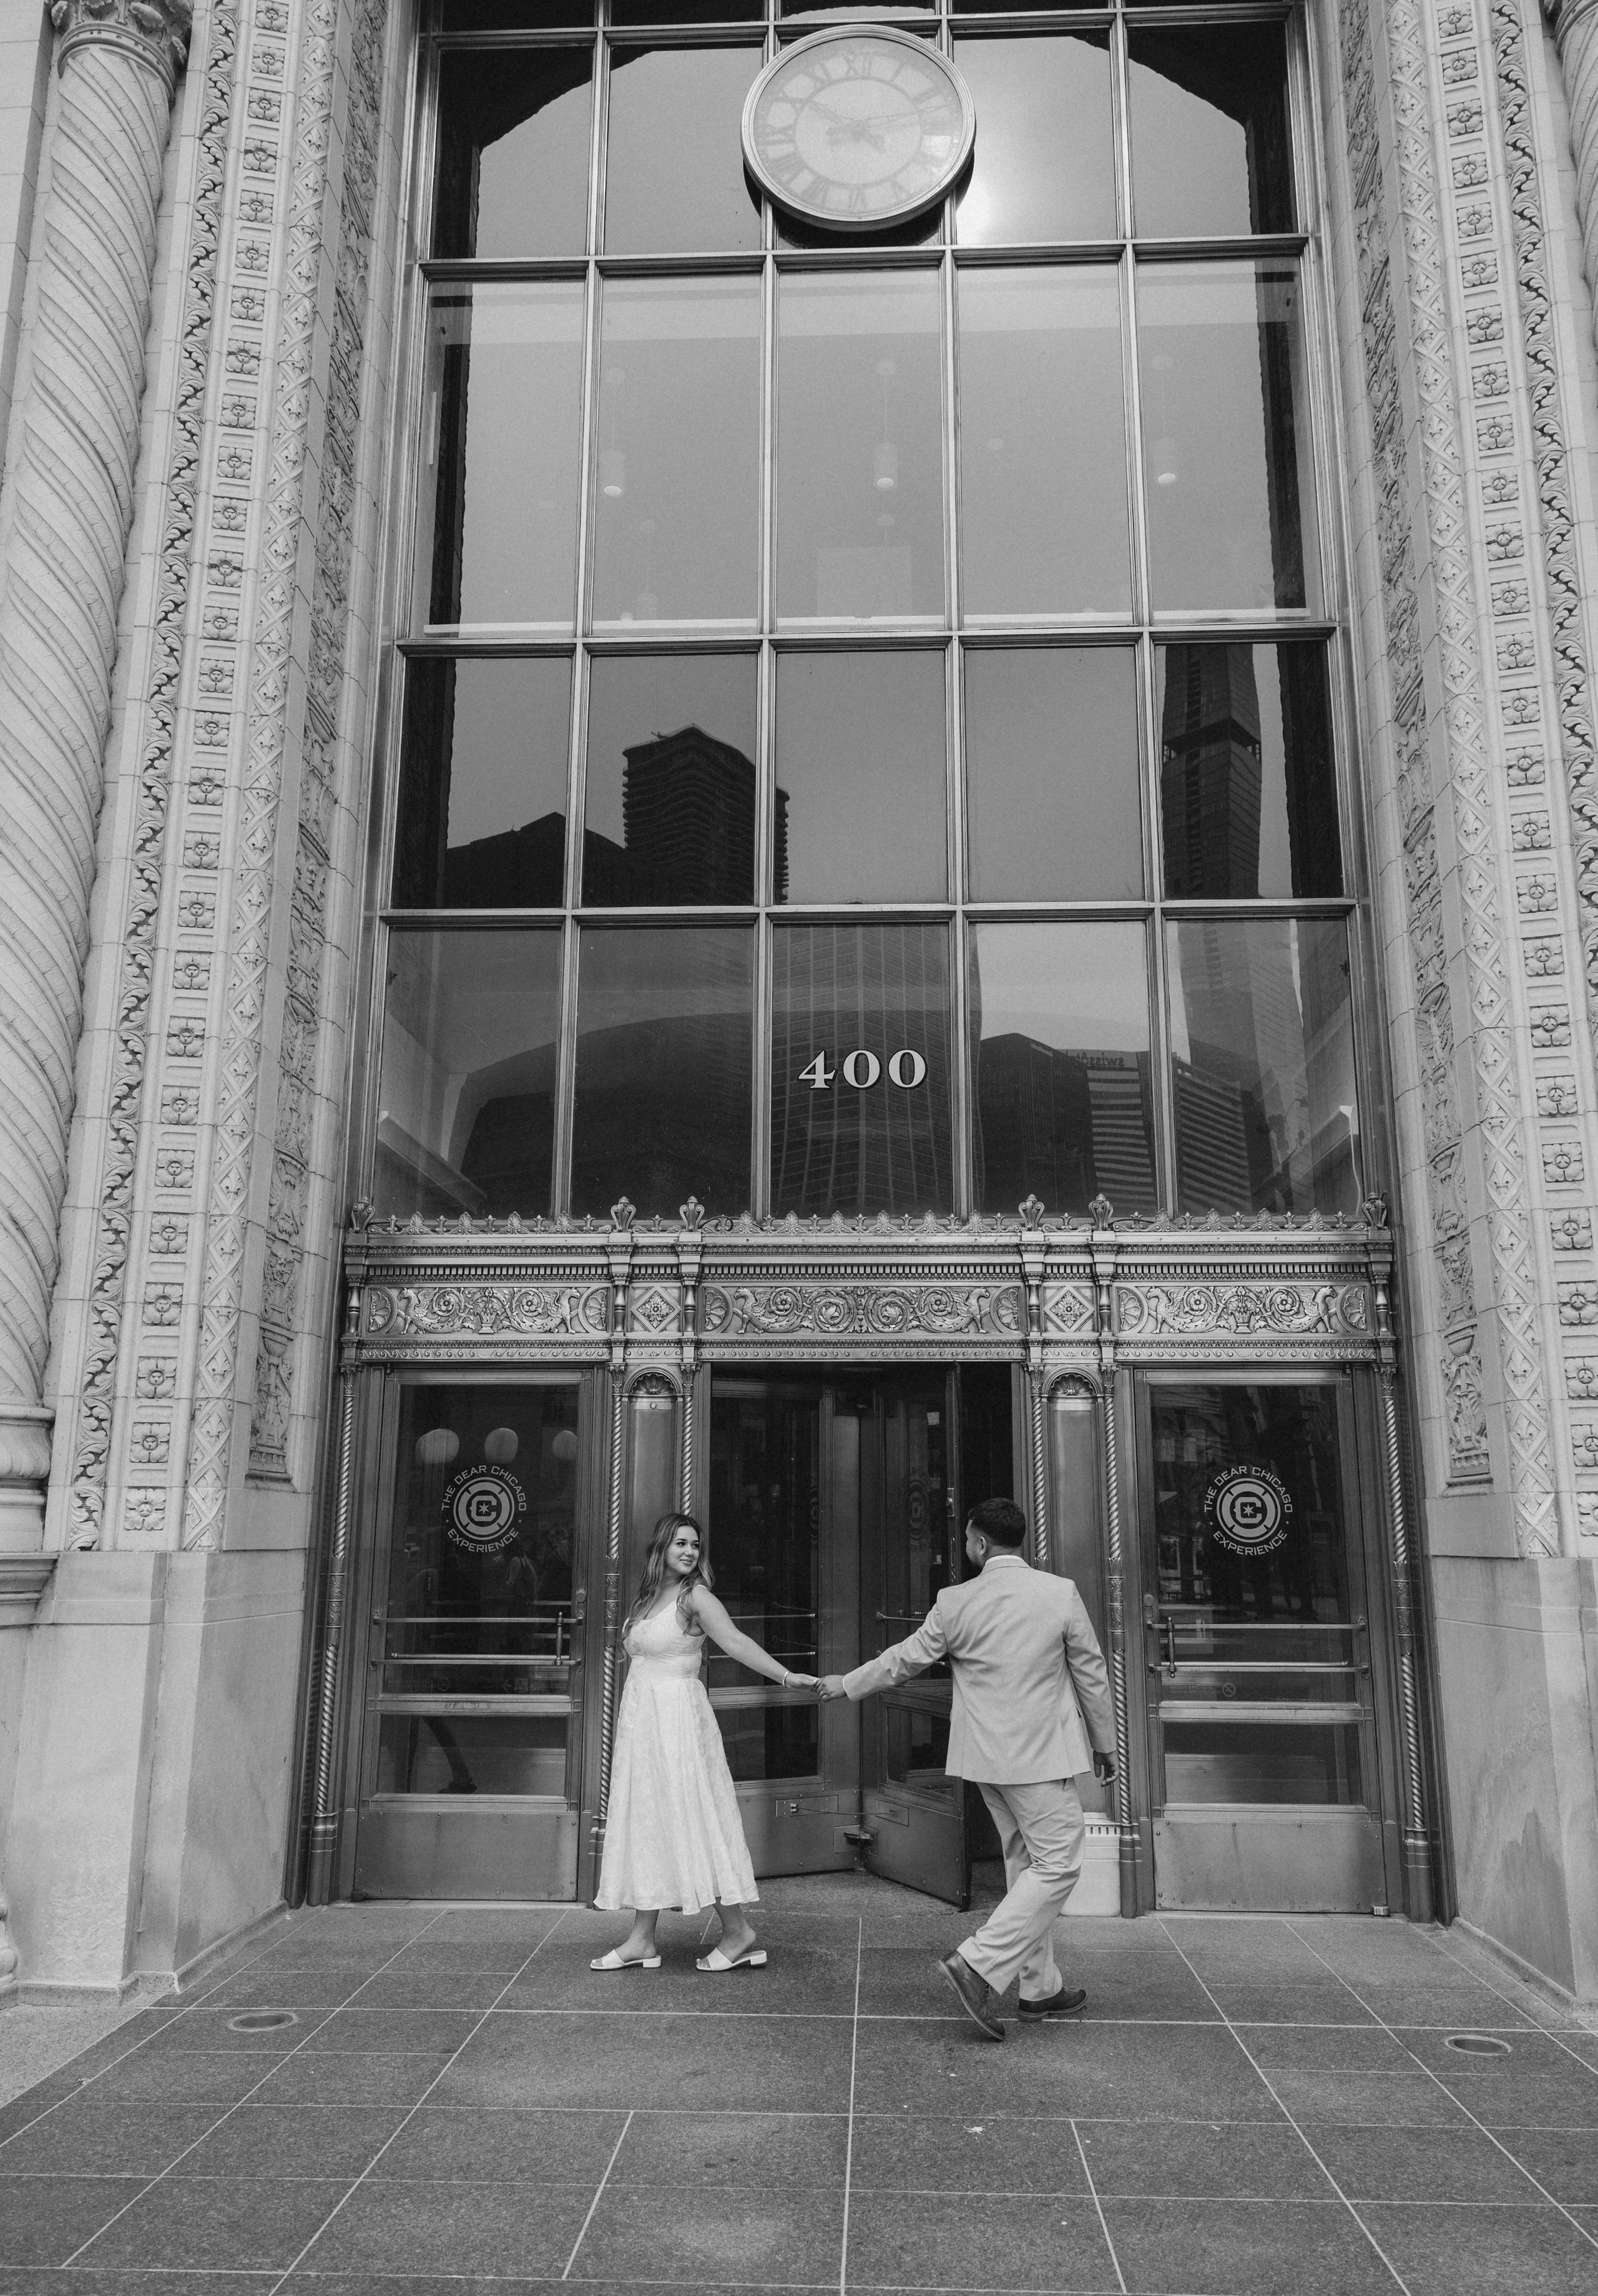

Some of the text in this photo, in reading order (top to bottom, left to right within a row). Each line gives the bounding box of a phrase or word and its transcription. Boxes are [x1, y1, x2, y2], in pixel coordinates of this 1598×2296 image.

[798, 1049, 928, 1090] 400
[441, 1465, 527, 1511] THE DEAR CHICAGO
[1204, 1466, 1293, 1513] THE DEAR CHICAGO
[448, 1528, 519, 1553] EXPERIENCE
[1213, 1530, 1287, 1556] EXPERIENCE
